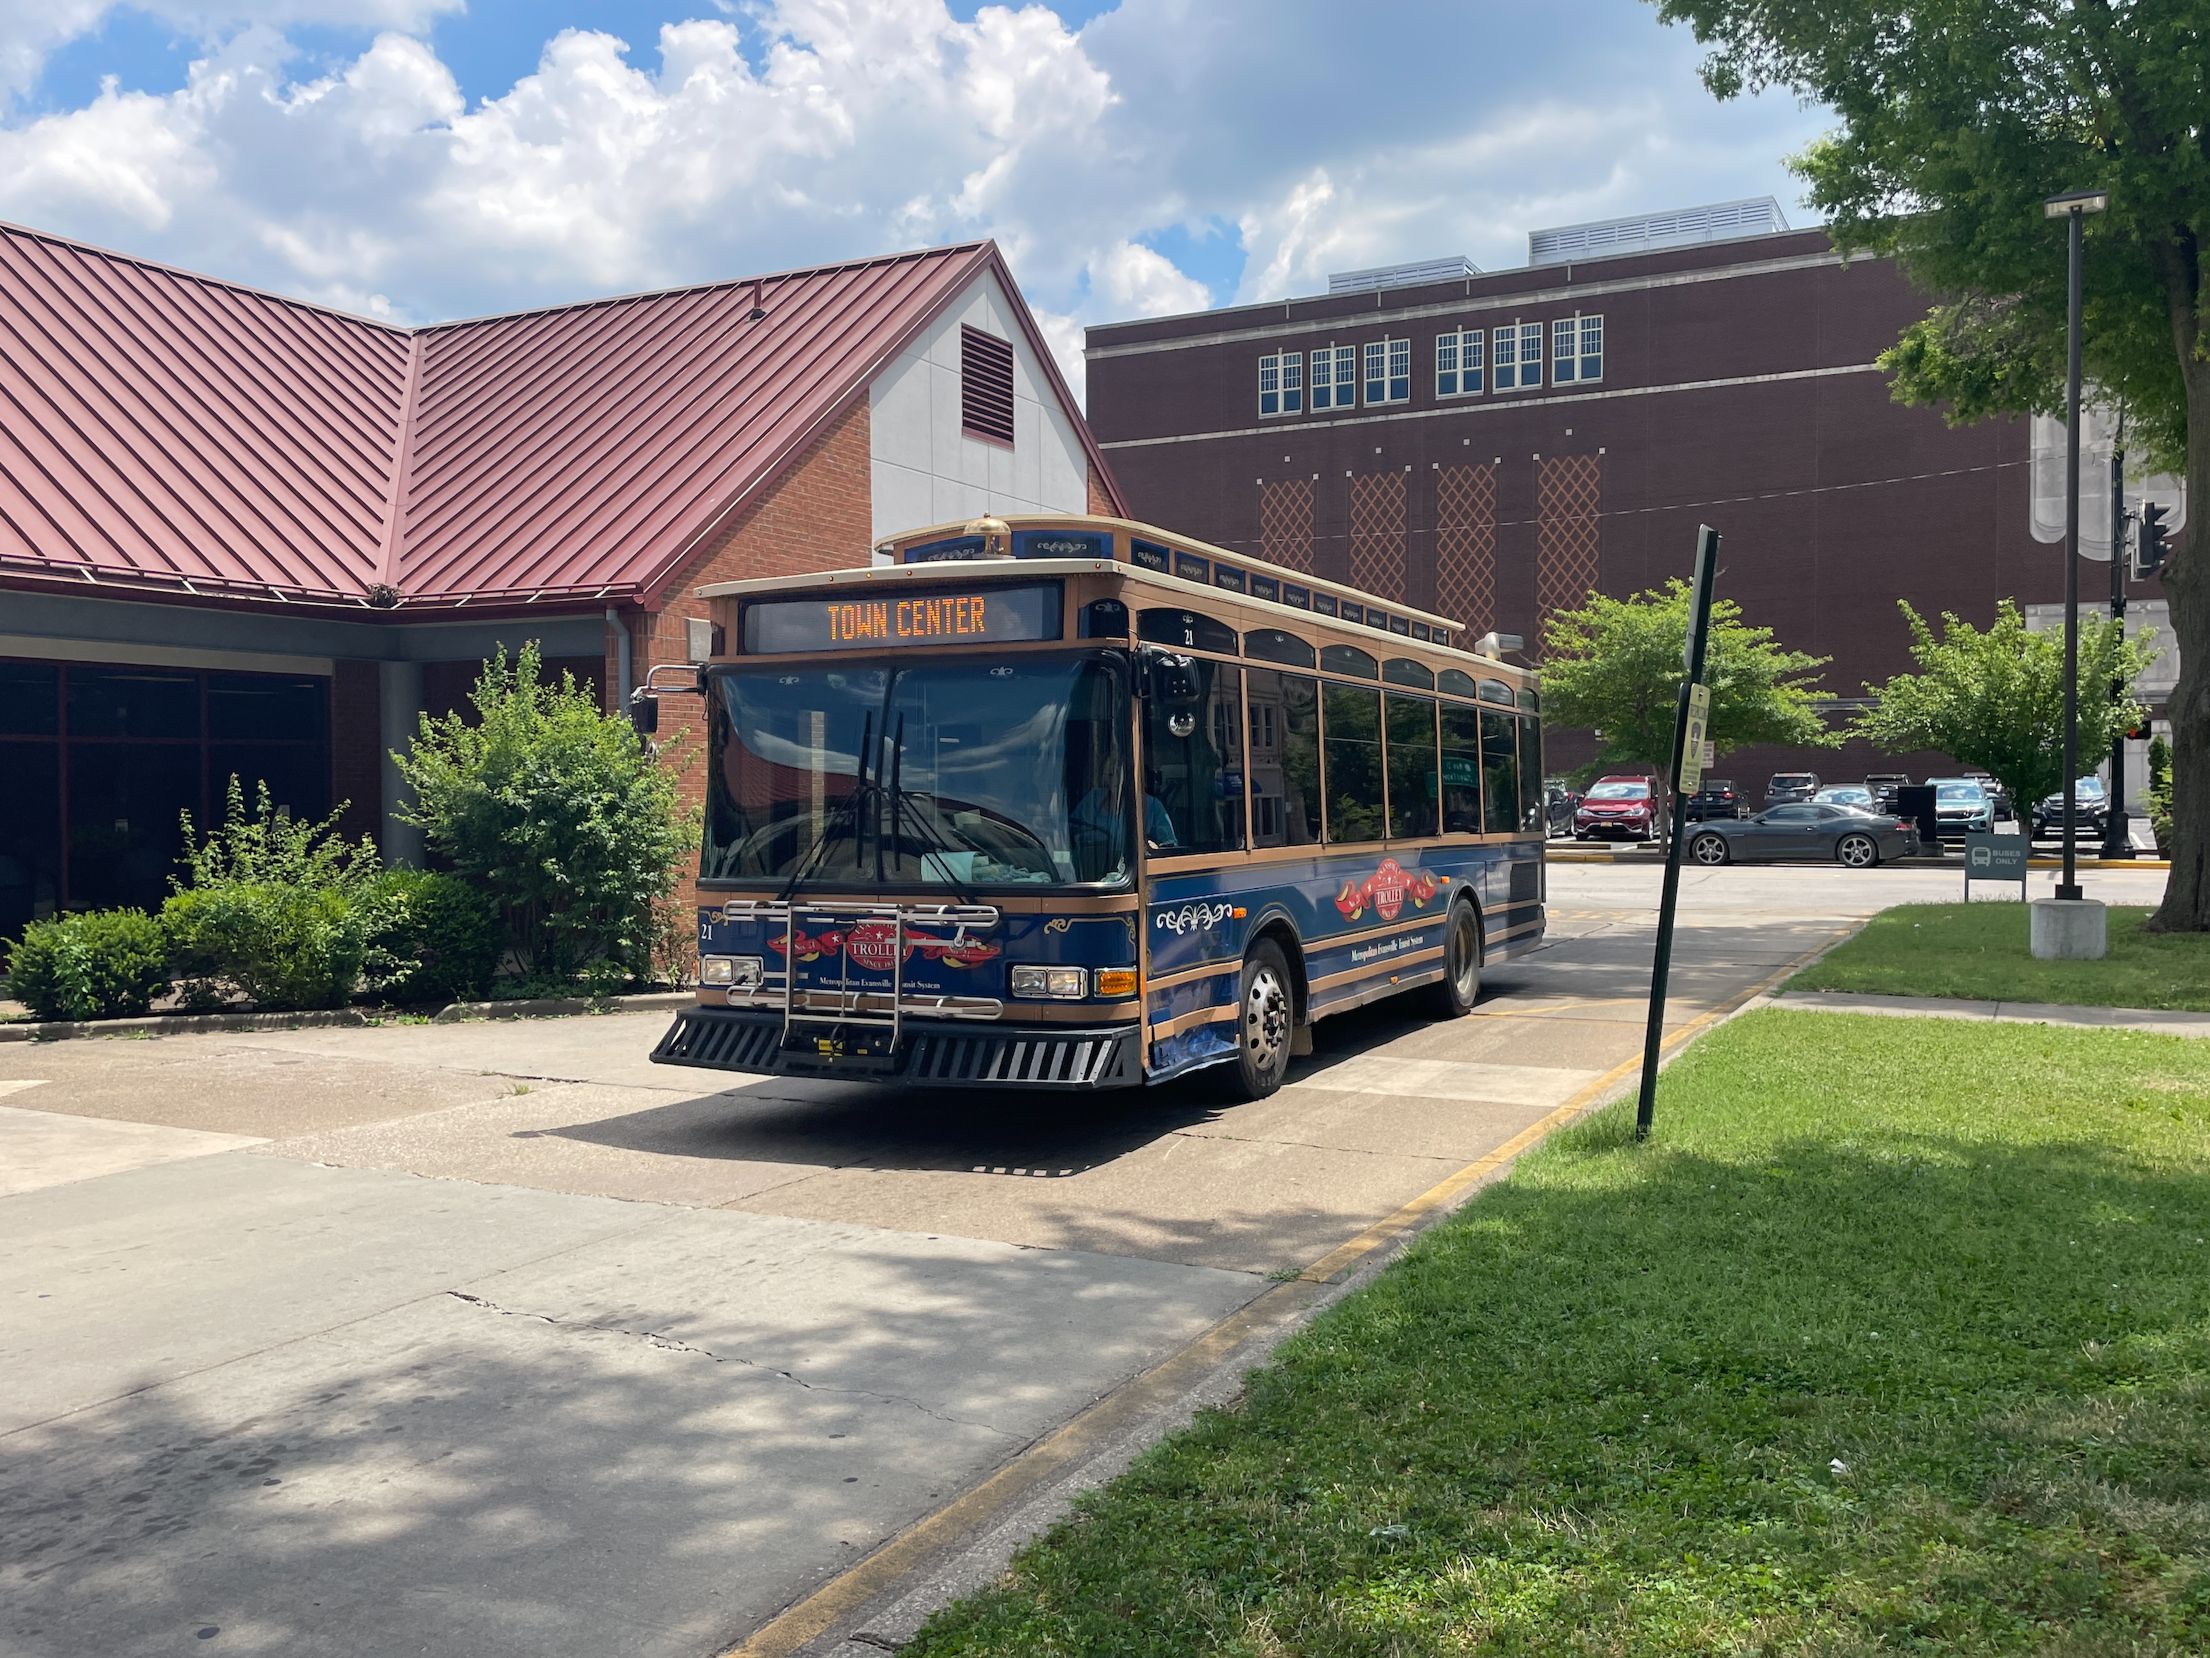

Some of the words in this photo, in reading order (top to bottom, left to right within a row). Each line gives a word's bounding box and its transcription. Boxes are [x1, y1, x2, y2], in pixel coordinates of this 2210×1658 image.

[828, 603, 887, 640] TOWN
[897, 597, 985, 637] CENTER
[1184, 629, 1193, 646] 21
[1376, 888, 1403, 905] TROLLEY
[701, 923, 713, 940] 21
[851, 943, 907, 956] TROLL
[861, 978, 892, 988] Evansville
[916, 980, 941, 990] System
